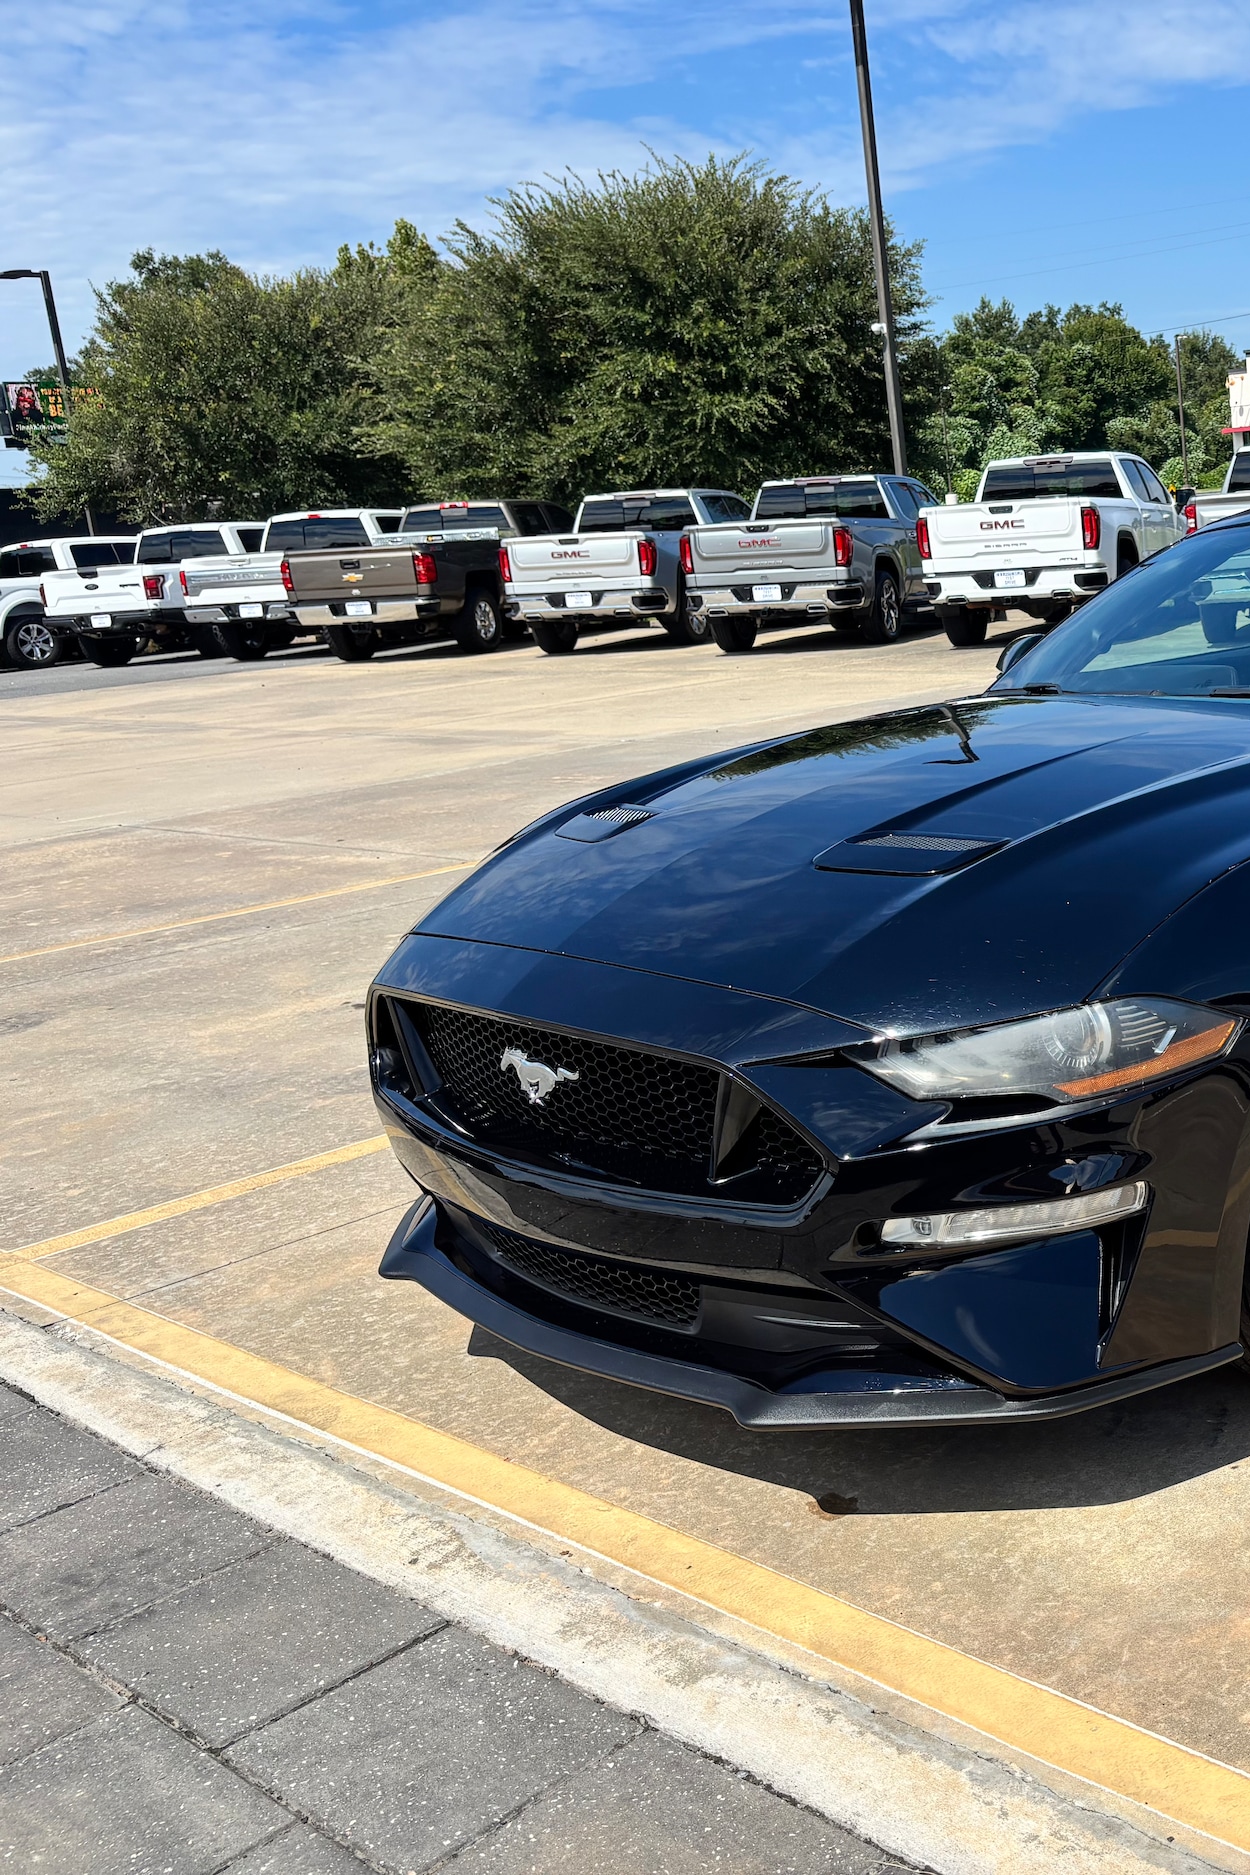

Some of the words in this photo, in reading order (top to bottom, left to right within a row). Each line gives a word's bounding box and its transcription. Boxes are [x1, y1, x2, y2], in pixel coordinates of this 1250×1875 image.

[980, 519, 1025, 530] GMC
[738, 537, 782, 548] GMC
[551, 550, 590, 559] GMC
